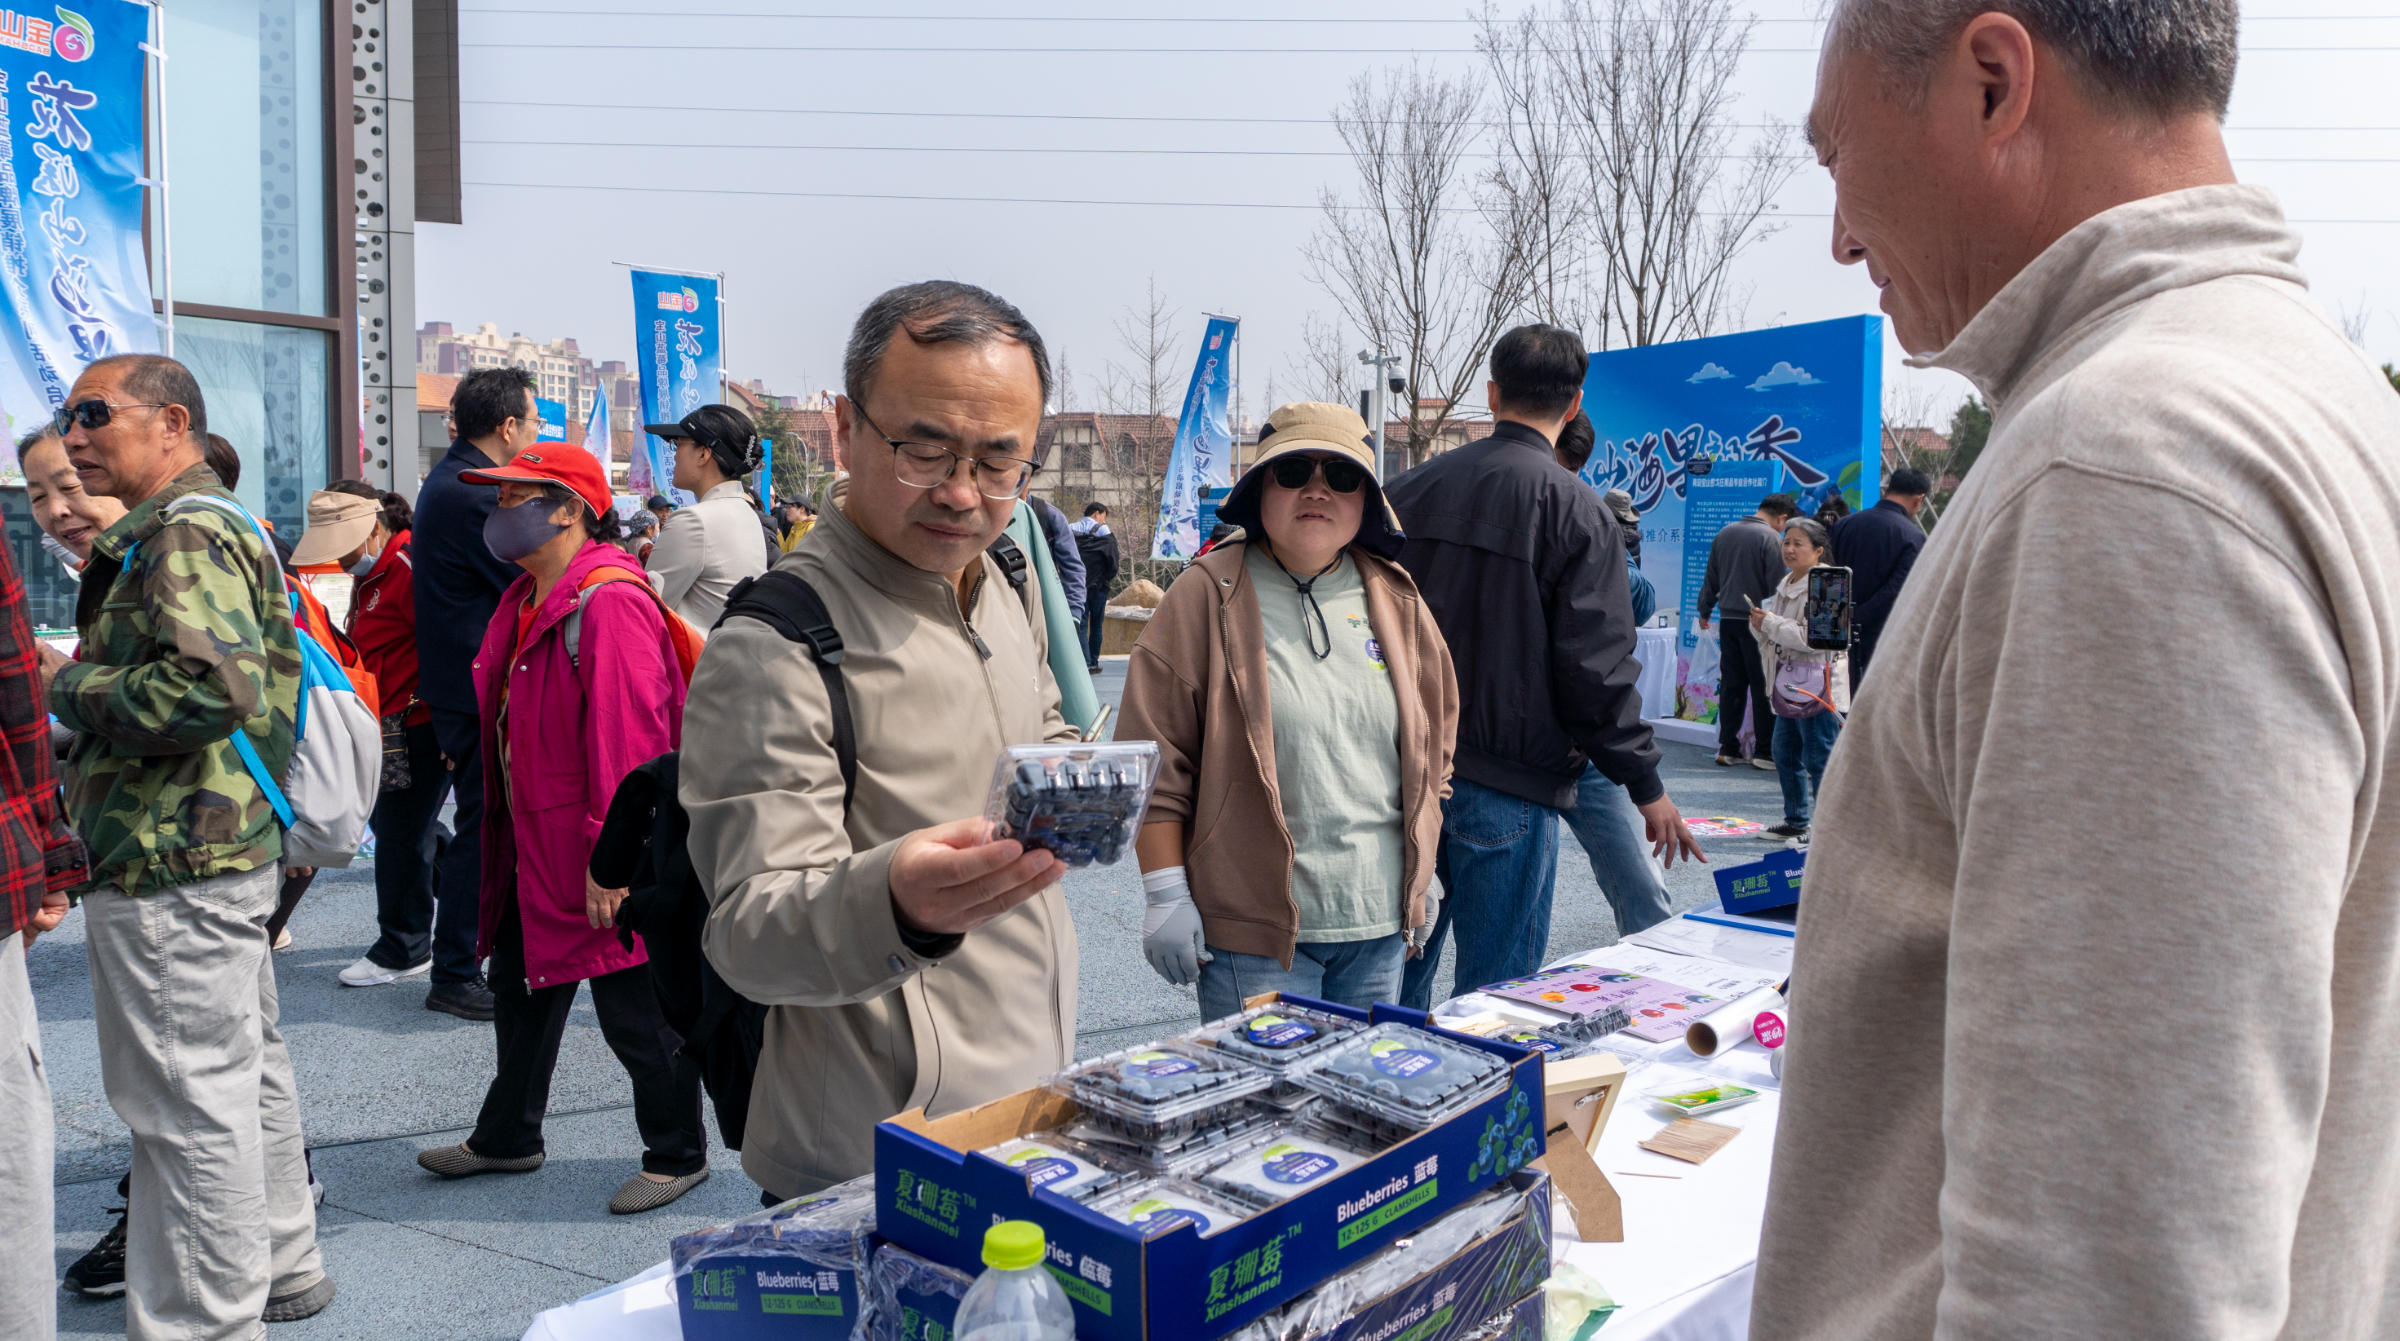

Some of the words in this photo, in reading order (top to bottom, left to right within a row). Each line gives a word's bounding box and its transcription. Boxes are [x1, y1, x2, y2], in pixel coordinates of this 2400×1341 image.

[1639, 528, 1685, 543] 推介系
[1732, 873, 1768, 893] 夏珊莓
[1734, 887, 1771, 899] Xiashanmei
[1413, 1154, 1439, 1185] 蓝莓
[894, 1167, 961, 1223] 夏珊莓
[962, 1193, 977, 1209] TM
[1337, 1174, 1409, 1224] Blueberries
[894, 1196, 960, 1239] Xiashanmei
[1341, 1219, 1370, 1242] 12-125
[1372, 1215, 1379, 1226] G
[1384, 1187, 1430, 1219] CLAMSHELLS
[1083, 1255, 1112, 1289] 蓝莓
[1206, 1233, 1286, 1305] 夏珊莓
[1287, 1222, 1302, 1239] TM
[691, 1267, 736, 1299] 夏珊莓
[756, 1271, 813, 1289] Blueberries
[816, 1271, 840, 1292] 蓝莓
[693, 1298, 738, 1311] Xiashanmei
[763, 1298, 786, 1309] 12-125
[1204, 1270, 1283, 1324] Xiashanmei
[1432, 1281, 1457, 1311] 蓝莓
